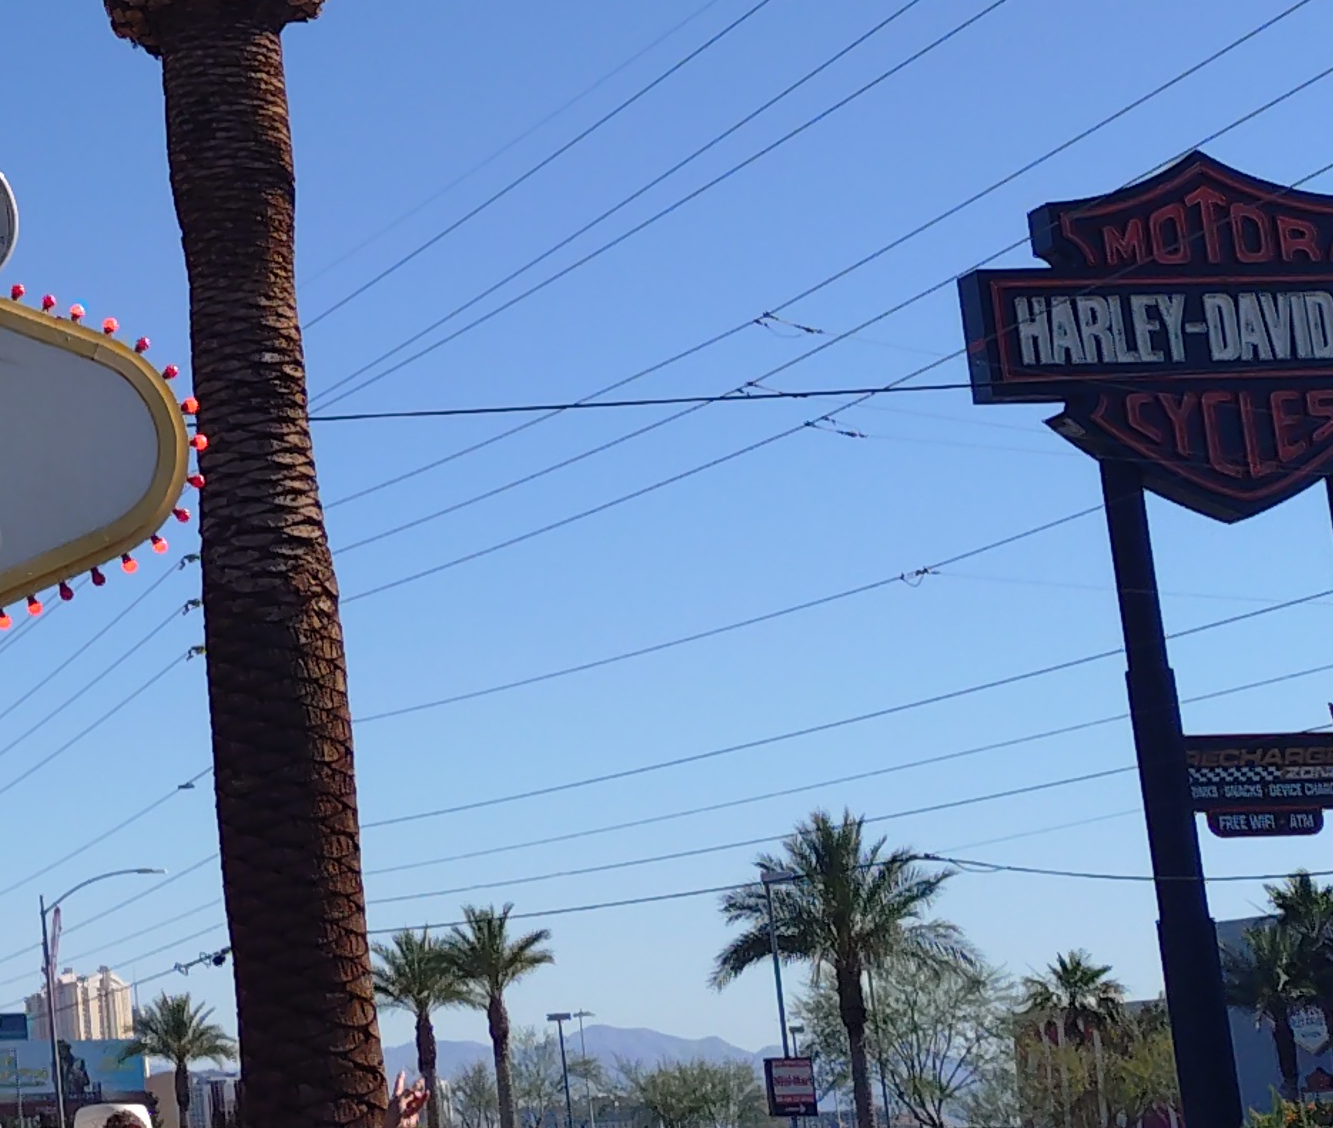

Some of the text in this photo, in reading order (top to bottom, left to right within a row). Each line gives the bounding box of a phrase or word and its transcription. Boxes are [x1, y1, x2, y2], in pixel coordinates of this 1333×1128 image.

[1103, 185, 1322, 265] MOTOR
[1014, 291, 1333, 365] HARLEY-DAVID
[1284, 767, 1333, 779] ZON
[1218, 814, 1248, 830] FREE
